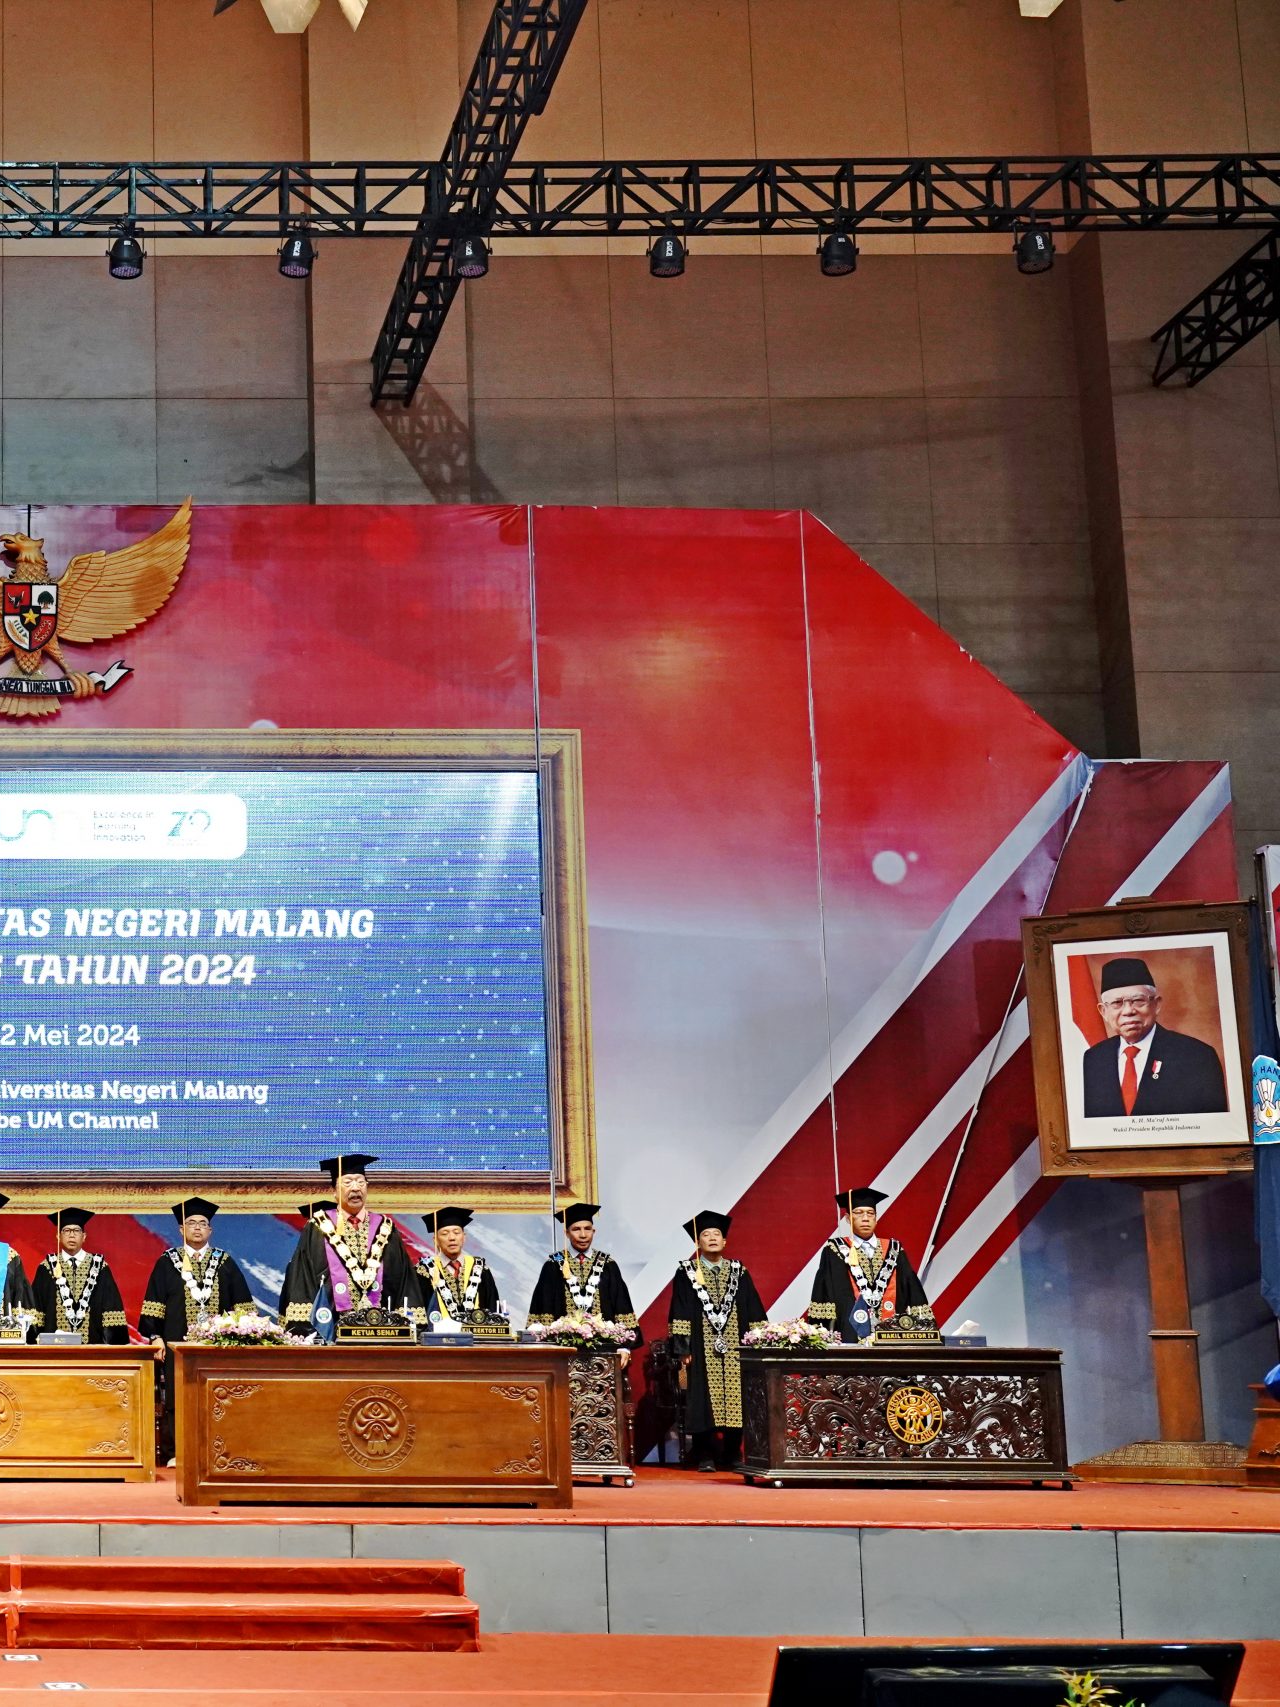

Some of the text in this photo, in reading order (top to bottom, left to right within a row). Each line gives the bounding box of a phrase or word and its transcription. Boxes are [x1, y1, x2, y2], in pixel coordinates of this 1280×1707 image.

[64, 908, 200, 937] NEGERI
[214, 909, 375, 938] MALANG
[15, 954, 149, 985] TAHUN
[159, 954, 257, 985] 2024
[22, 1024, 70, 1046] Mei
[77, 1024, 141, 1046] 2024
[101, 1080, 177, 1104] Negeri
[183, 1080, 269, 1104] Malang
[27, 1112, 64, 1128] UM
[69, 1111, 159, 1129] Channel
